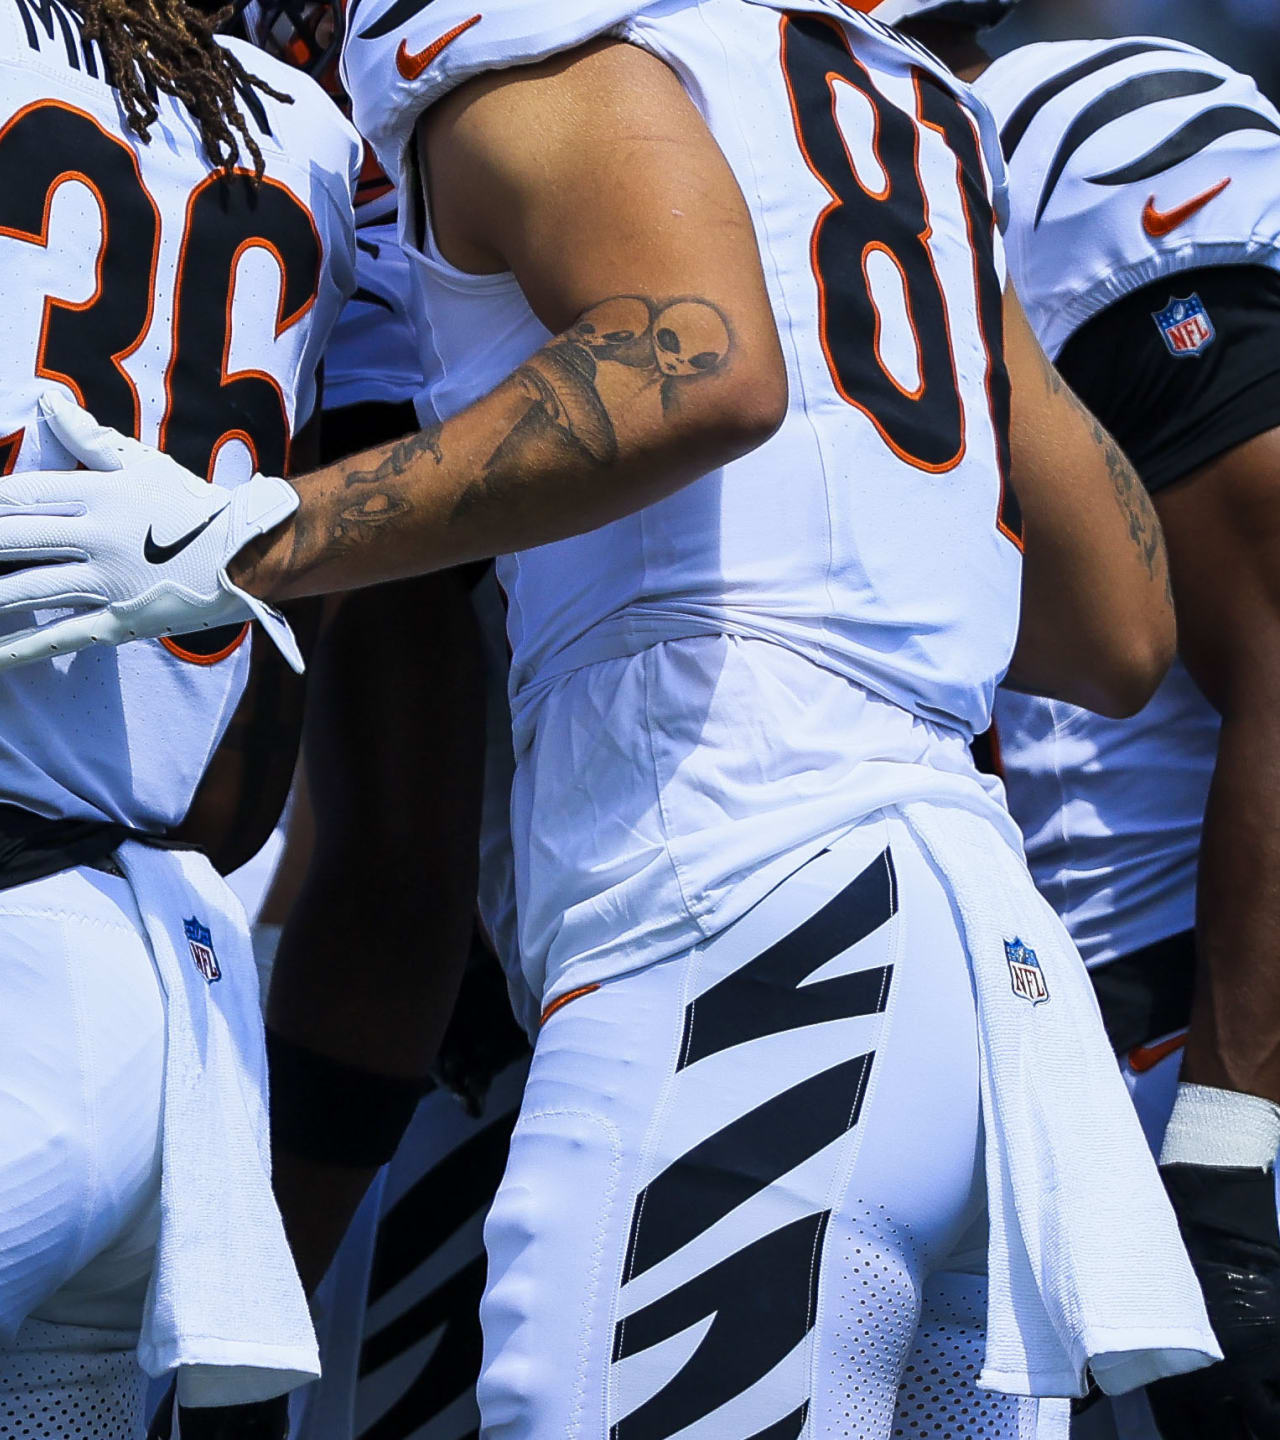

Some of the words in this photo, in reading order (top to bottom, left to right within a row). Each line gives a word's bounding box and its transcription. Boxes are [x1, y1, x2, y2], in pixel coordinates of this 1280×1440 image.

[1166, 317, 1211, 350] NFL
[189, 941, 218, 980] NFL
[1011, 964, 1046, 1000] NFL
